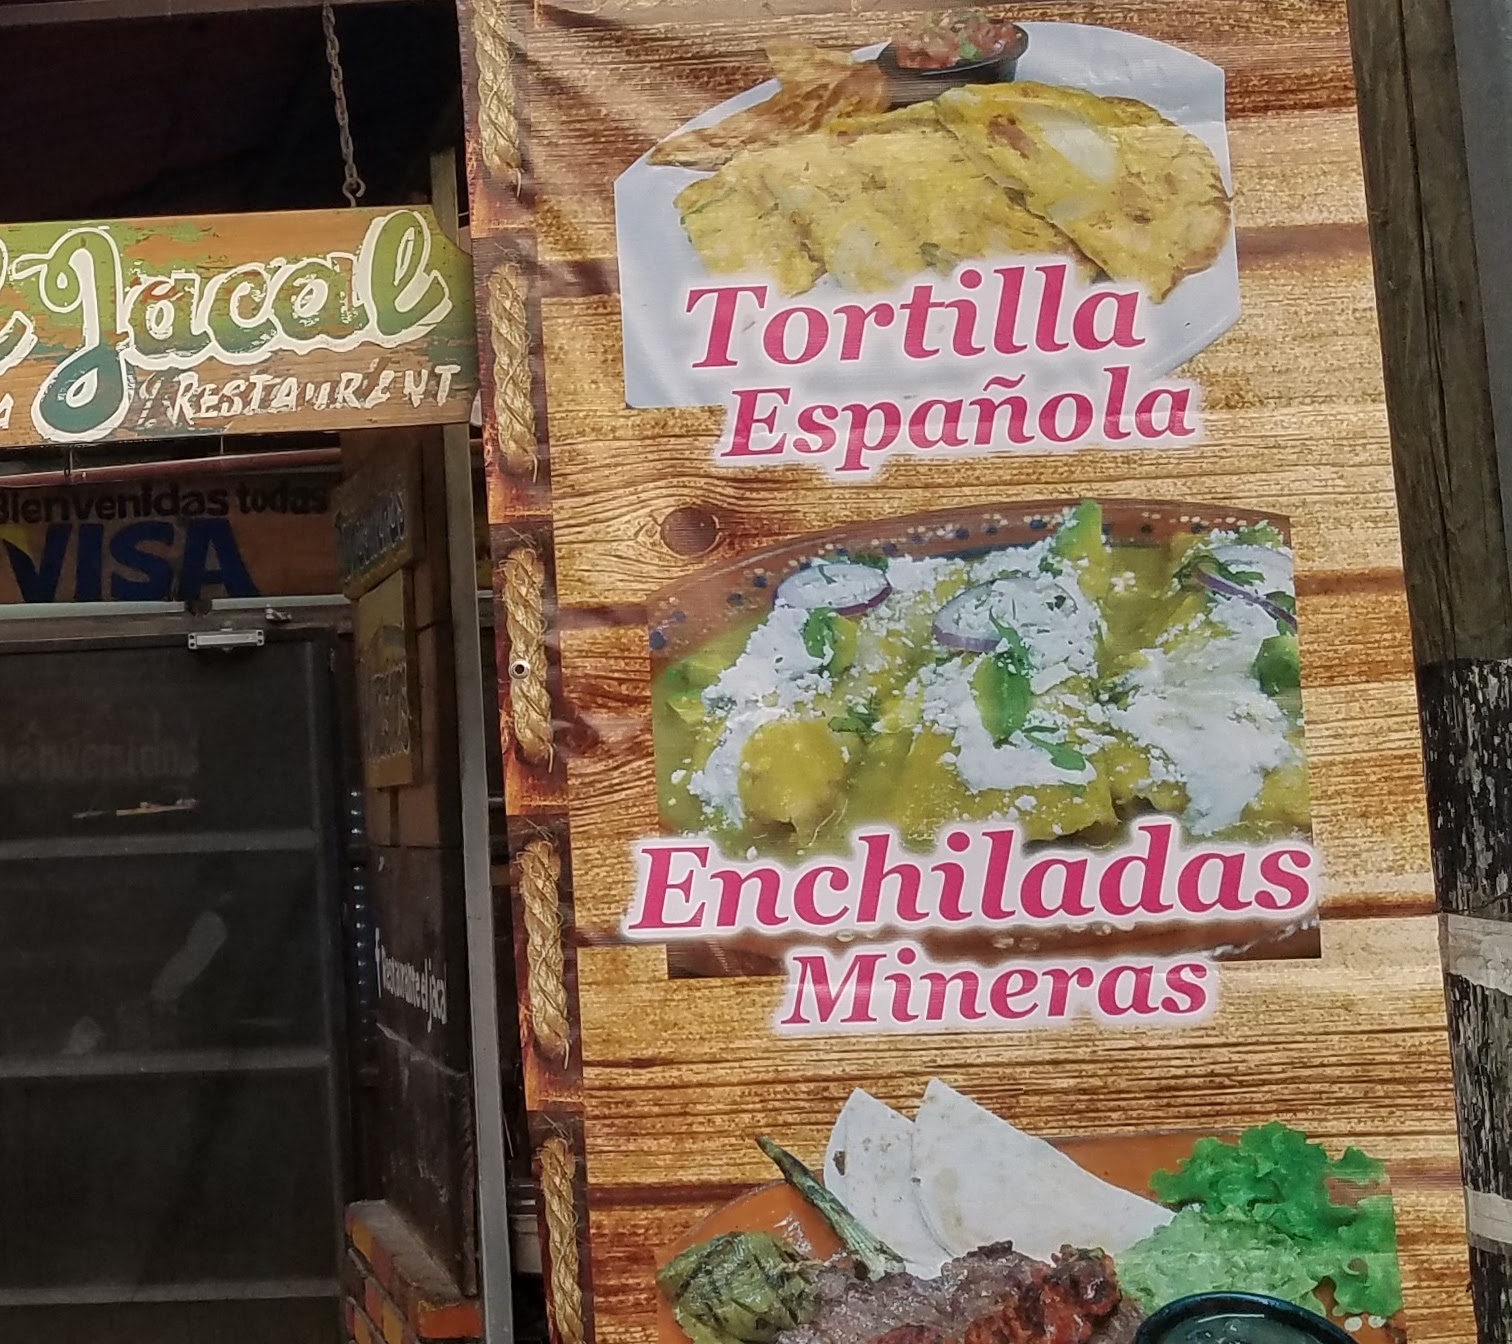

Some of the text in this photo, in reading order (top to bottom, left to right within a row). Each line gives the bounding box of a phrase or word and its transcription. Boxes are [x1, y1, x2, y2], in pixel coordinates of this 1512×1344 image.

[9, 210, 452, 442] Jacal
[685, 263, 1146, 369] Tortilla
[720, 365, 1196, 472] Española
[627, 822, 1314, 930] Enchiladas
[780, 949, 1208, 1026] Mineras
